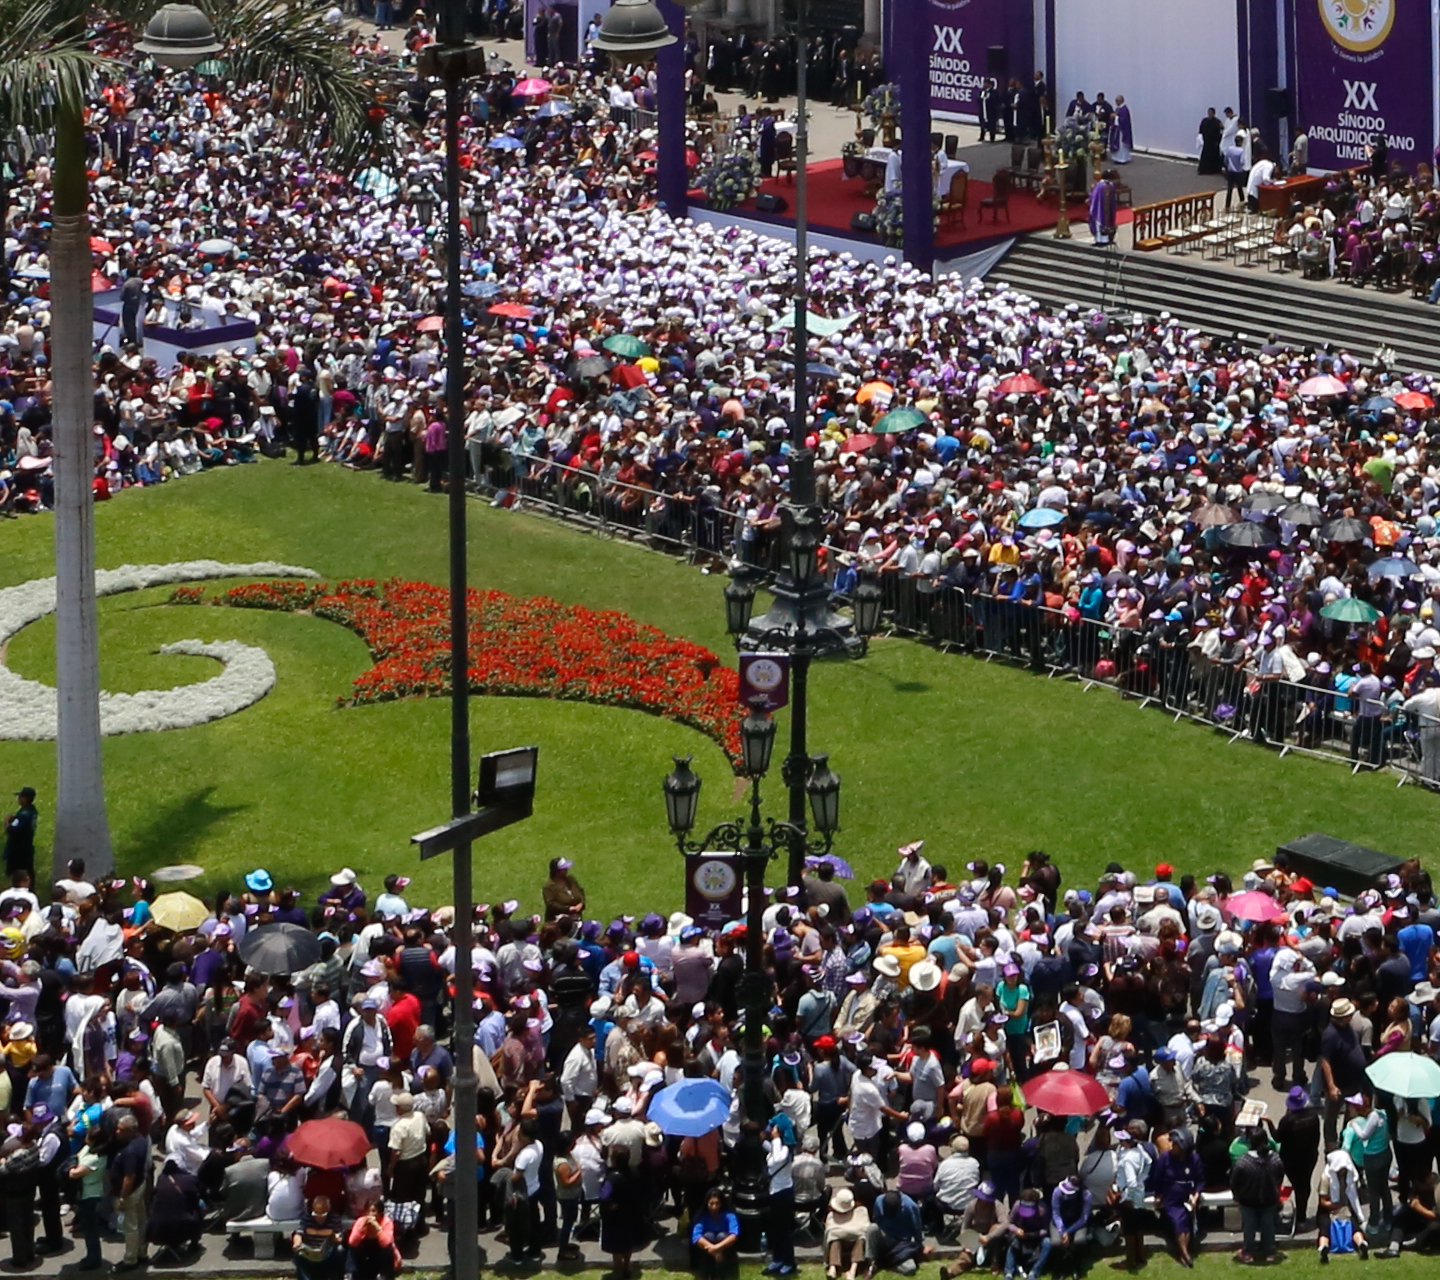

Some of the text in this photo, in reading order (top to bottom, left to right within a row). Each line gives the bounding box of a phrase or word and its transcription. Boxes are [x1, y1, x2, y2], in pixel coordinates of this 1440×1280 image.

[933, 24, 964, 55] XX
[1342, 79, 1379, 112] XX
[1337, 110, 1385, 132] SÍNODO
